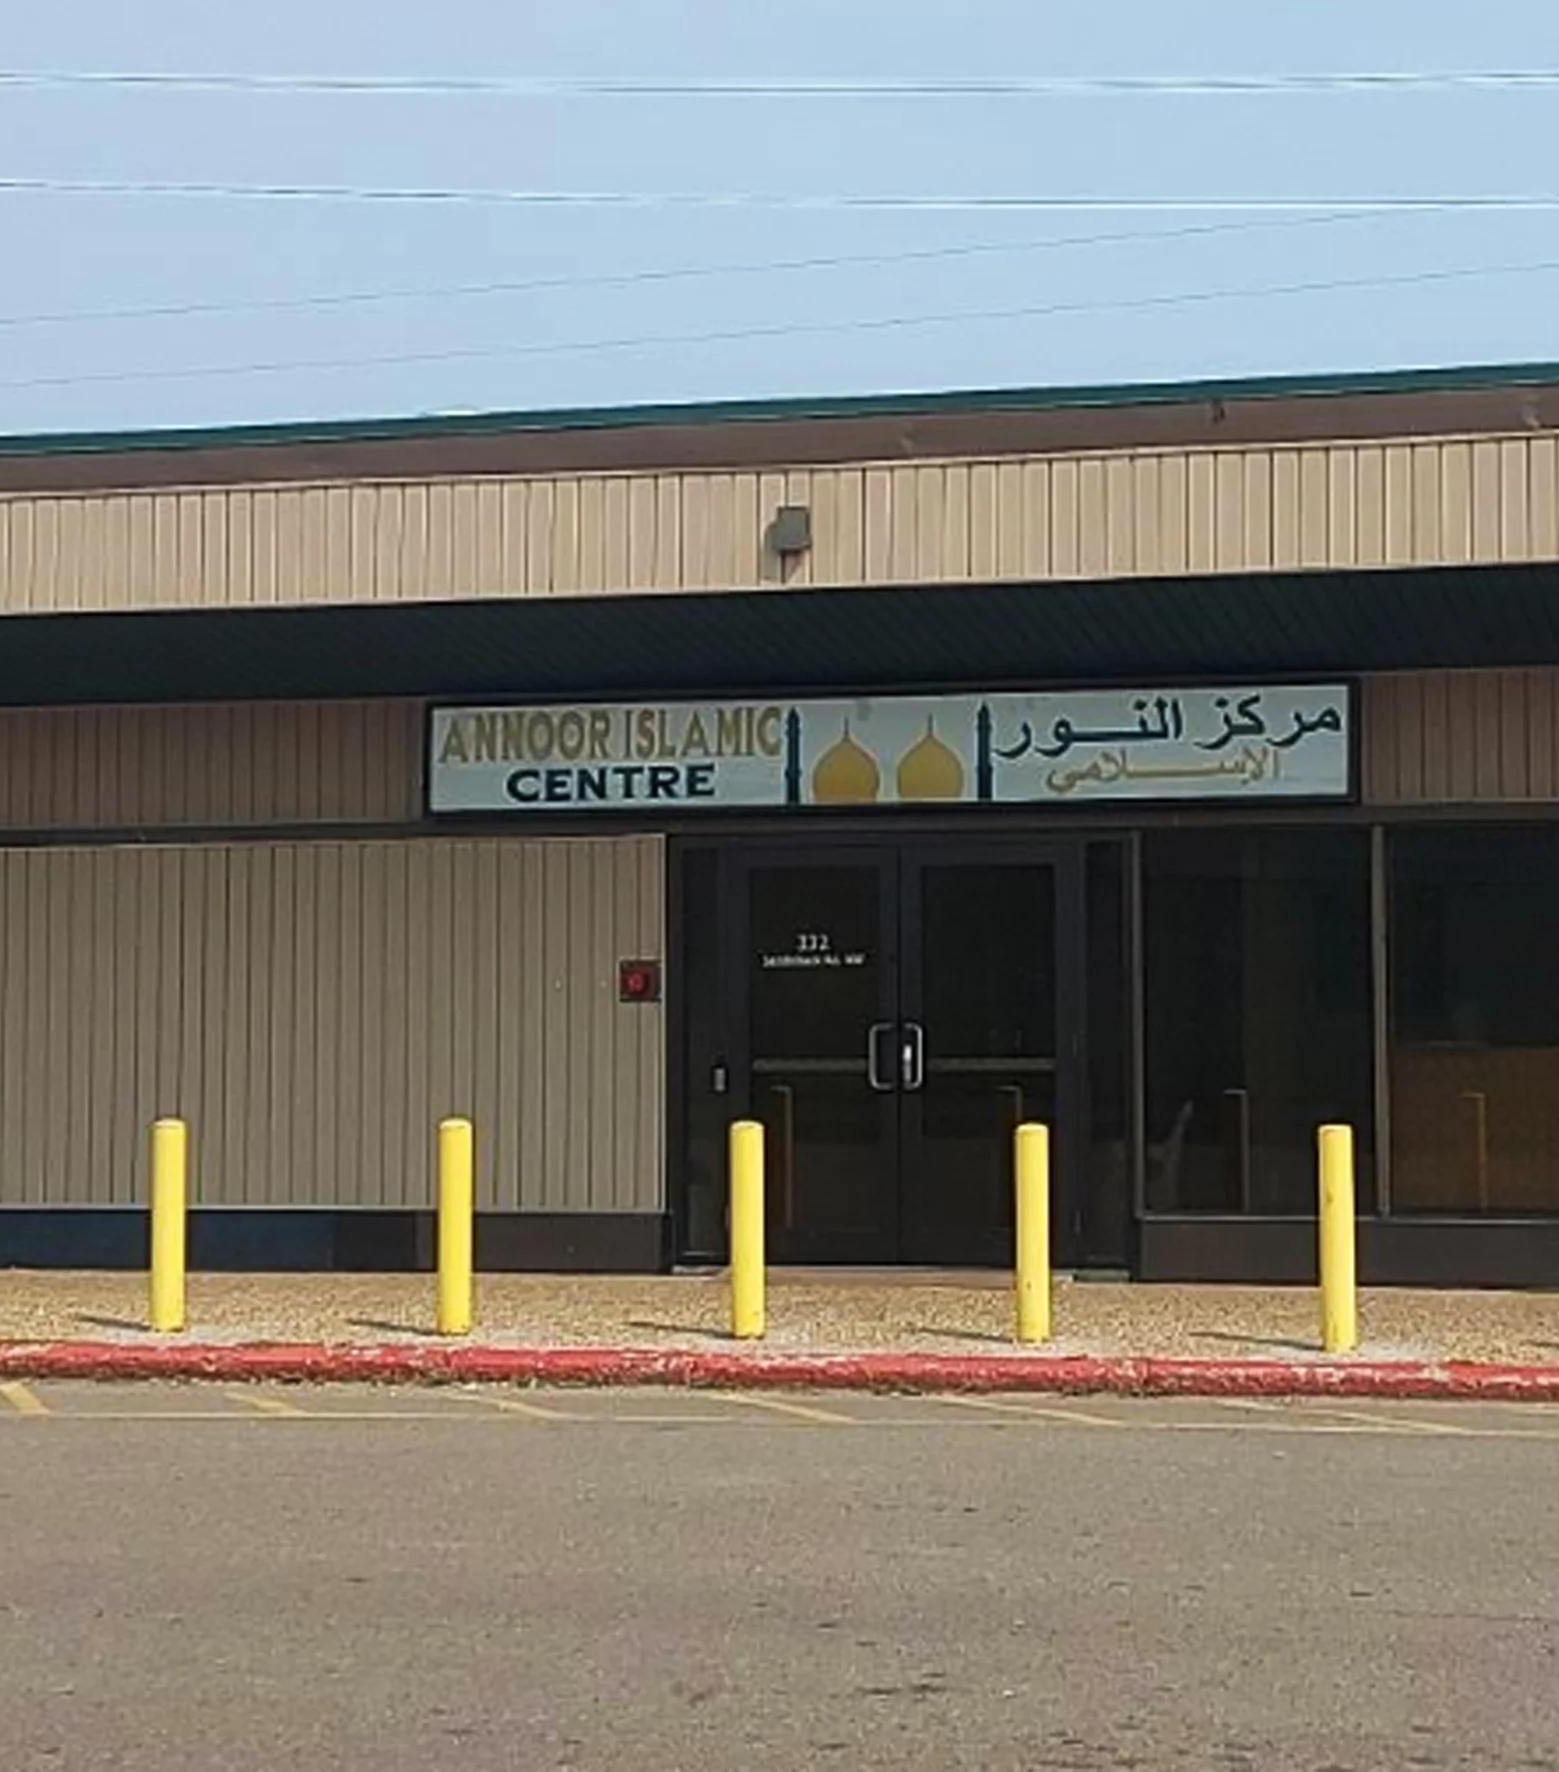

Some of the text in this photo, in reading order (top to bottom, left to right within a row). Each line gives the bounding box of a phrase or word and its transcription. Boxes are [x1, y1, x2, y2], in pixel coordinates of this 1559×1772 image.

[439, 705, 783, 763] ANNOOR ISLAMIC
[1194, 694, 1341, 750] مركز
[507, 763, 716, 803] CENTRE
